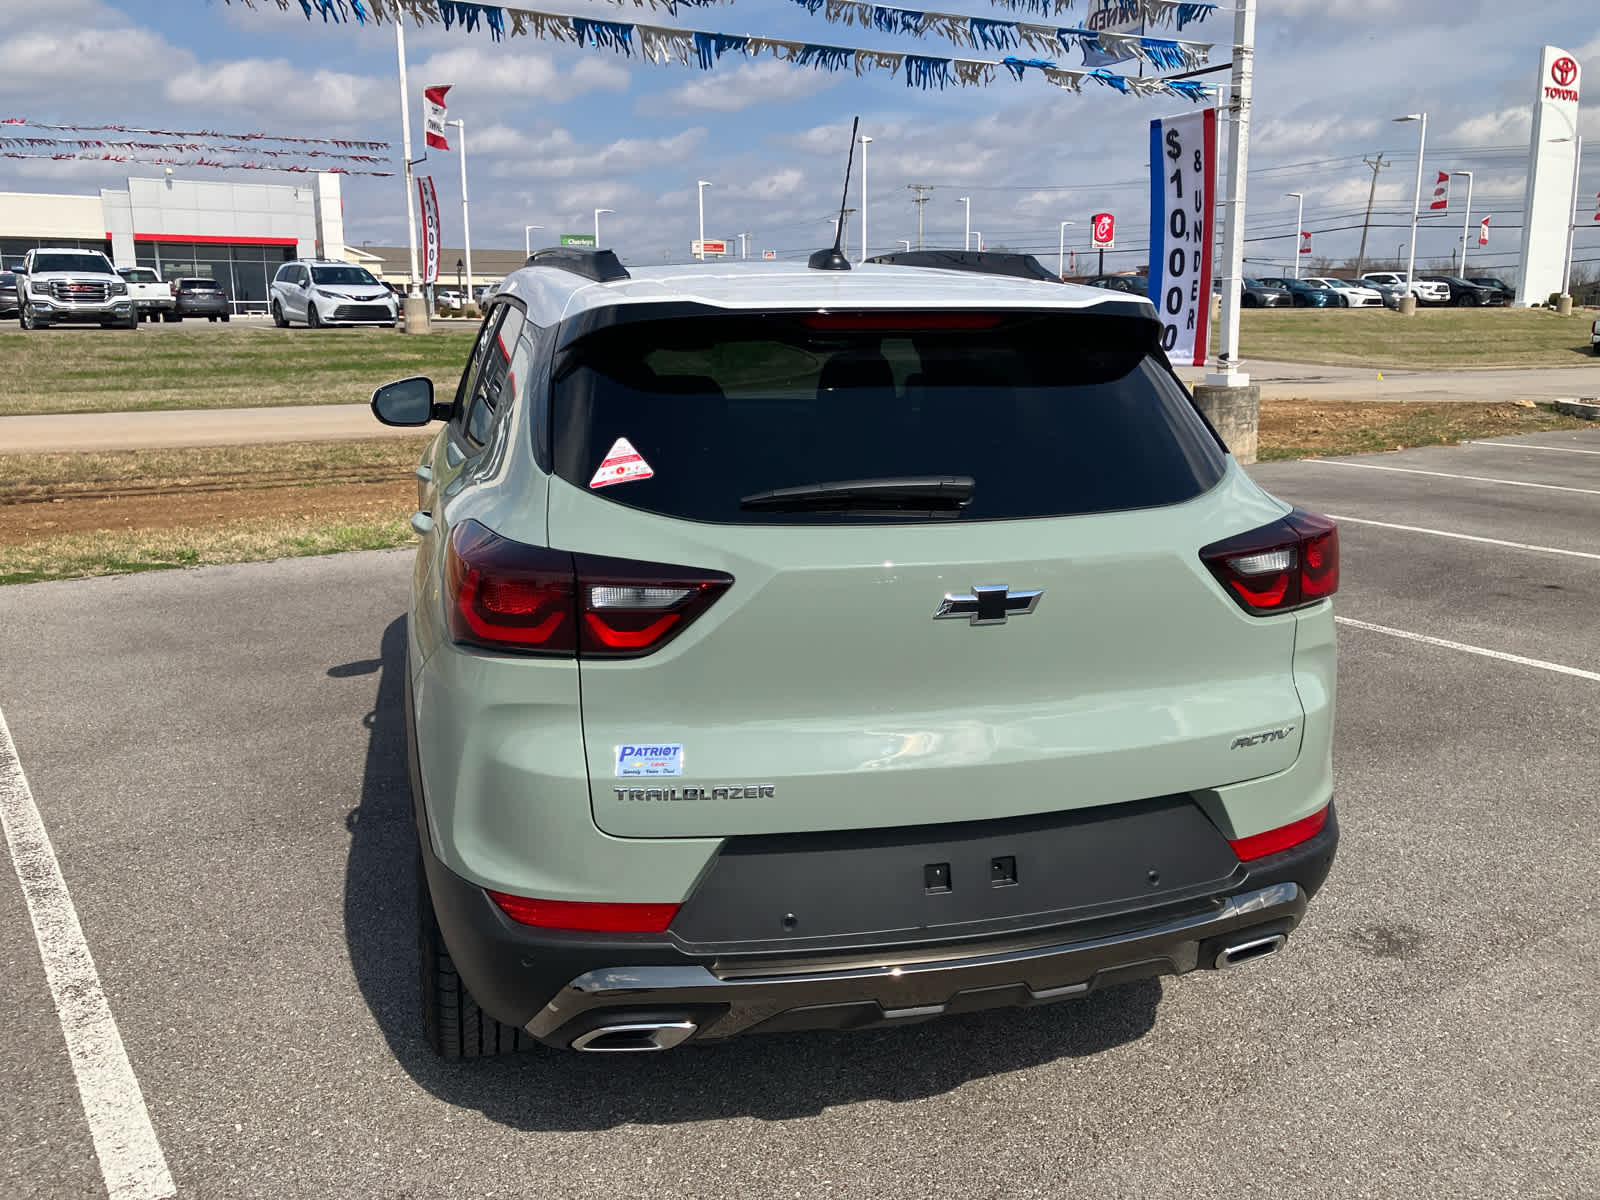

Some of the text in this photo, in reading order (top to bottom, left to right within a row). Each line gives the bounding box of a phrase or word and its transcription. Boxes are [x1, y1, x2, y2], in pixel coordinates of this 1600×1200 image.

[1545, 86, 1578, 102] TOYOTA
[1186, 190, 1203, 330] UNDER
[1230, 726, 1295, 750] ACTIV
[618, 746, 680, 762] PATRIOT
[613, 784, 775, 801] TRAILBLAZER
